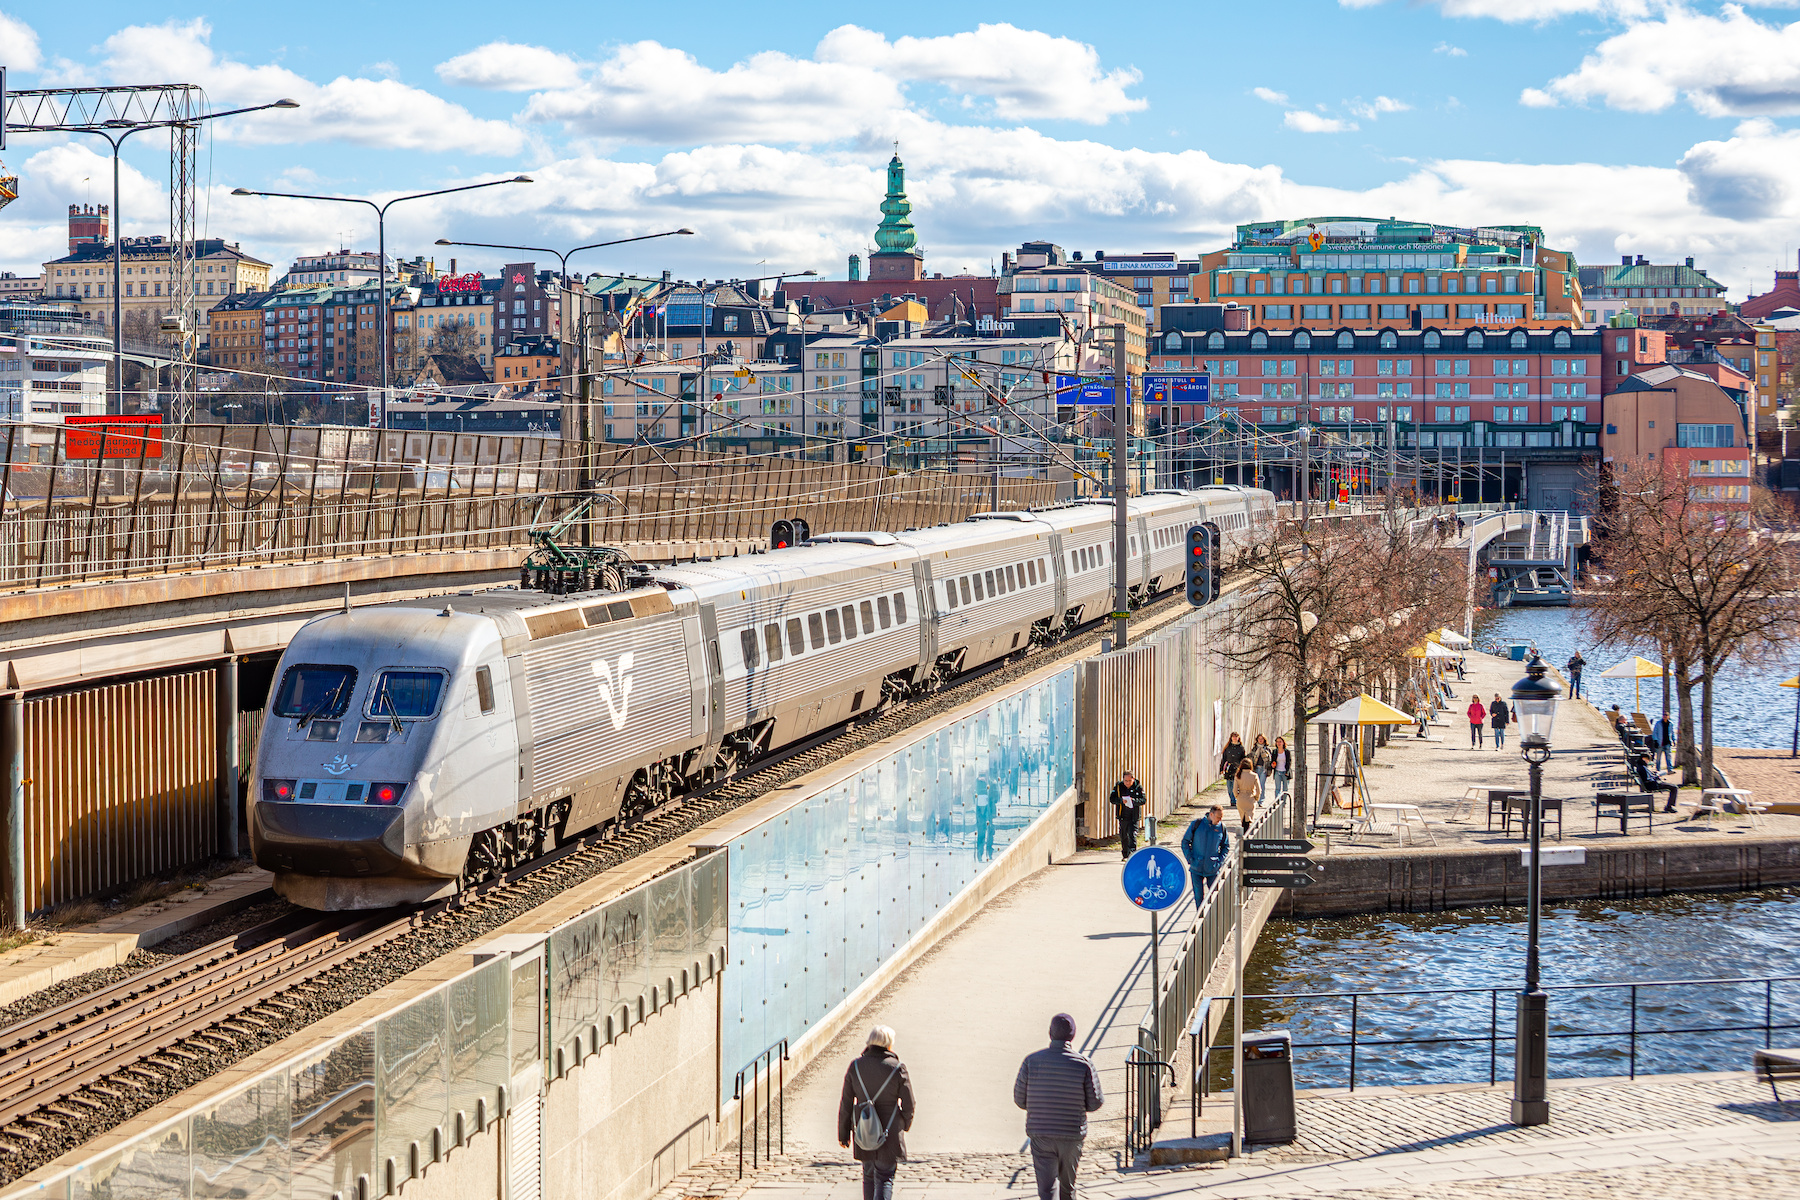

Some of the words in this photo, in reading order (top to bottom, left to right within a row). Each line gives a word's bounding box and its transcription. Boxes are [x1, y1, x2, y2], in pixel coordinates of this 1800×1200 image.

[1327, 243, 1355, 252] Sveriges
[1414, 243, 1444, 252] Regioner
[1474, 312, 1516, 324] Hilton
[975, 319, 1015, 331] Hilton
[333, 754, 348, 765] SJ
